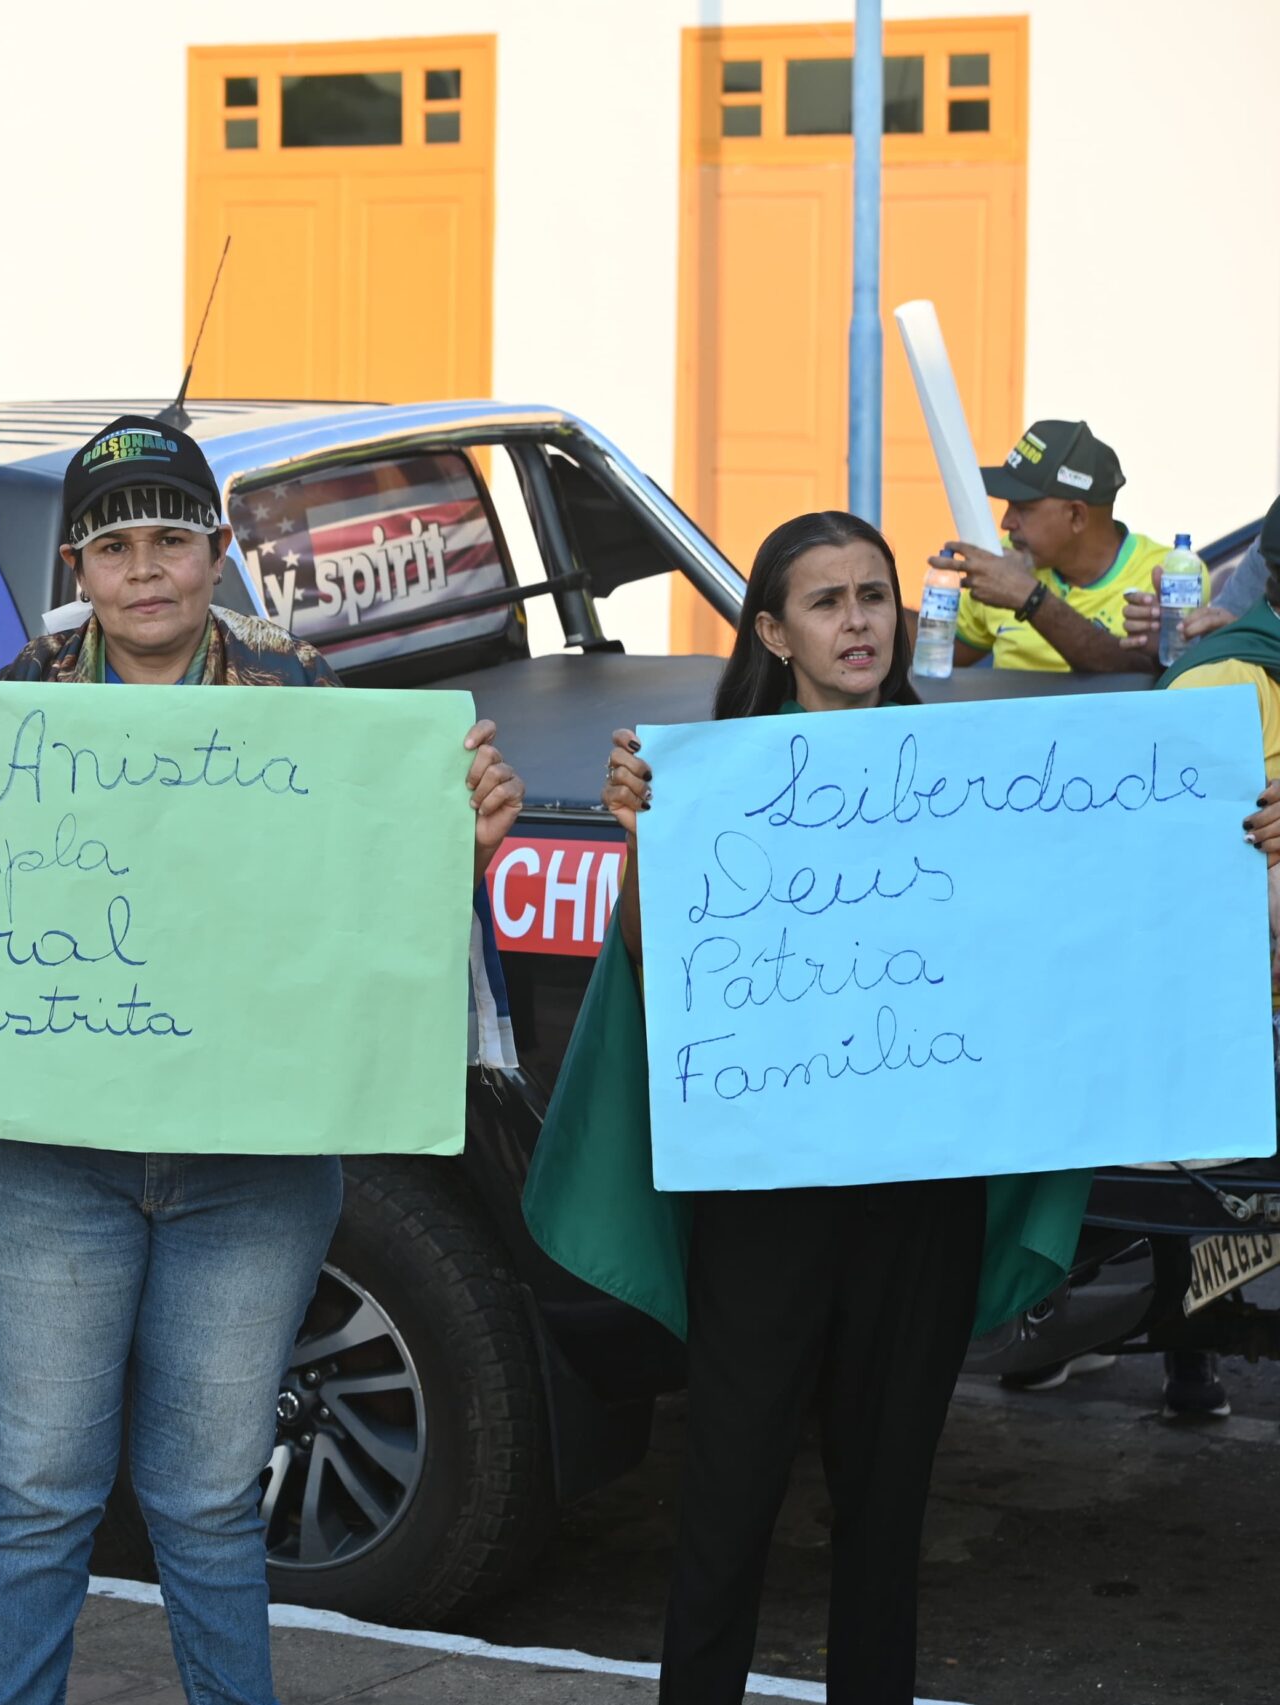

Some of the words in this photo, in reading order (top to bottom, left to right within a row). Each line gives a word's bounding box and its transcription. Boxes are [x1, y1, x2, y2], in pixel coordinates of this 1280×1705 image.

[82, 434, 178, 466] BOLSONARO
[114, 447, 142, 460] 2022
[316, 517, 447, 625] spirit
[744, 734, 1207, 829] Liberdade
[688, 831, 955, 924] Deus
